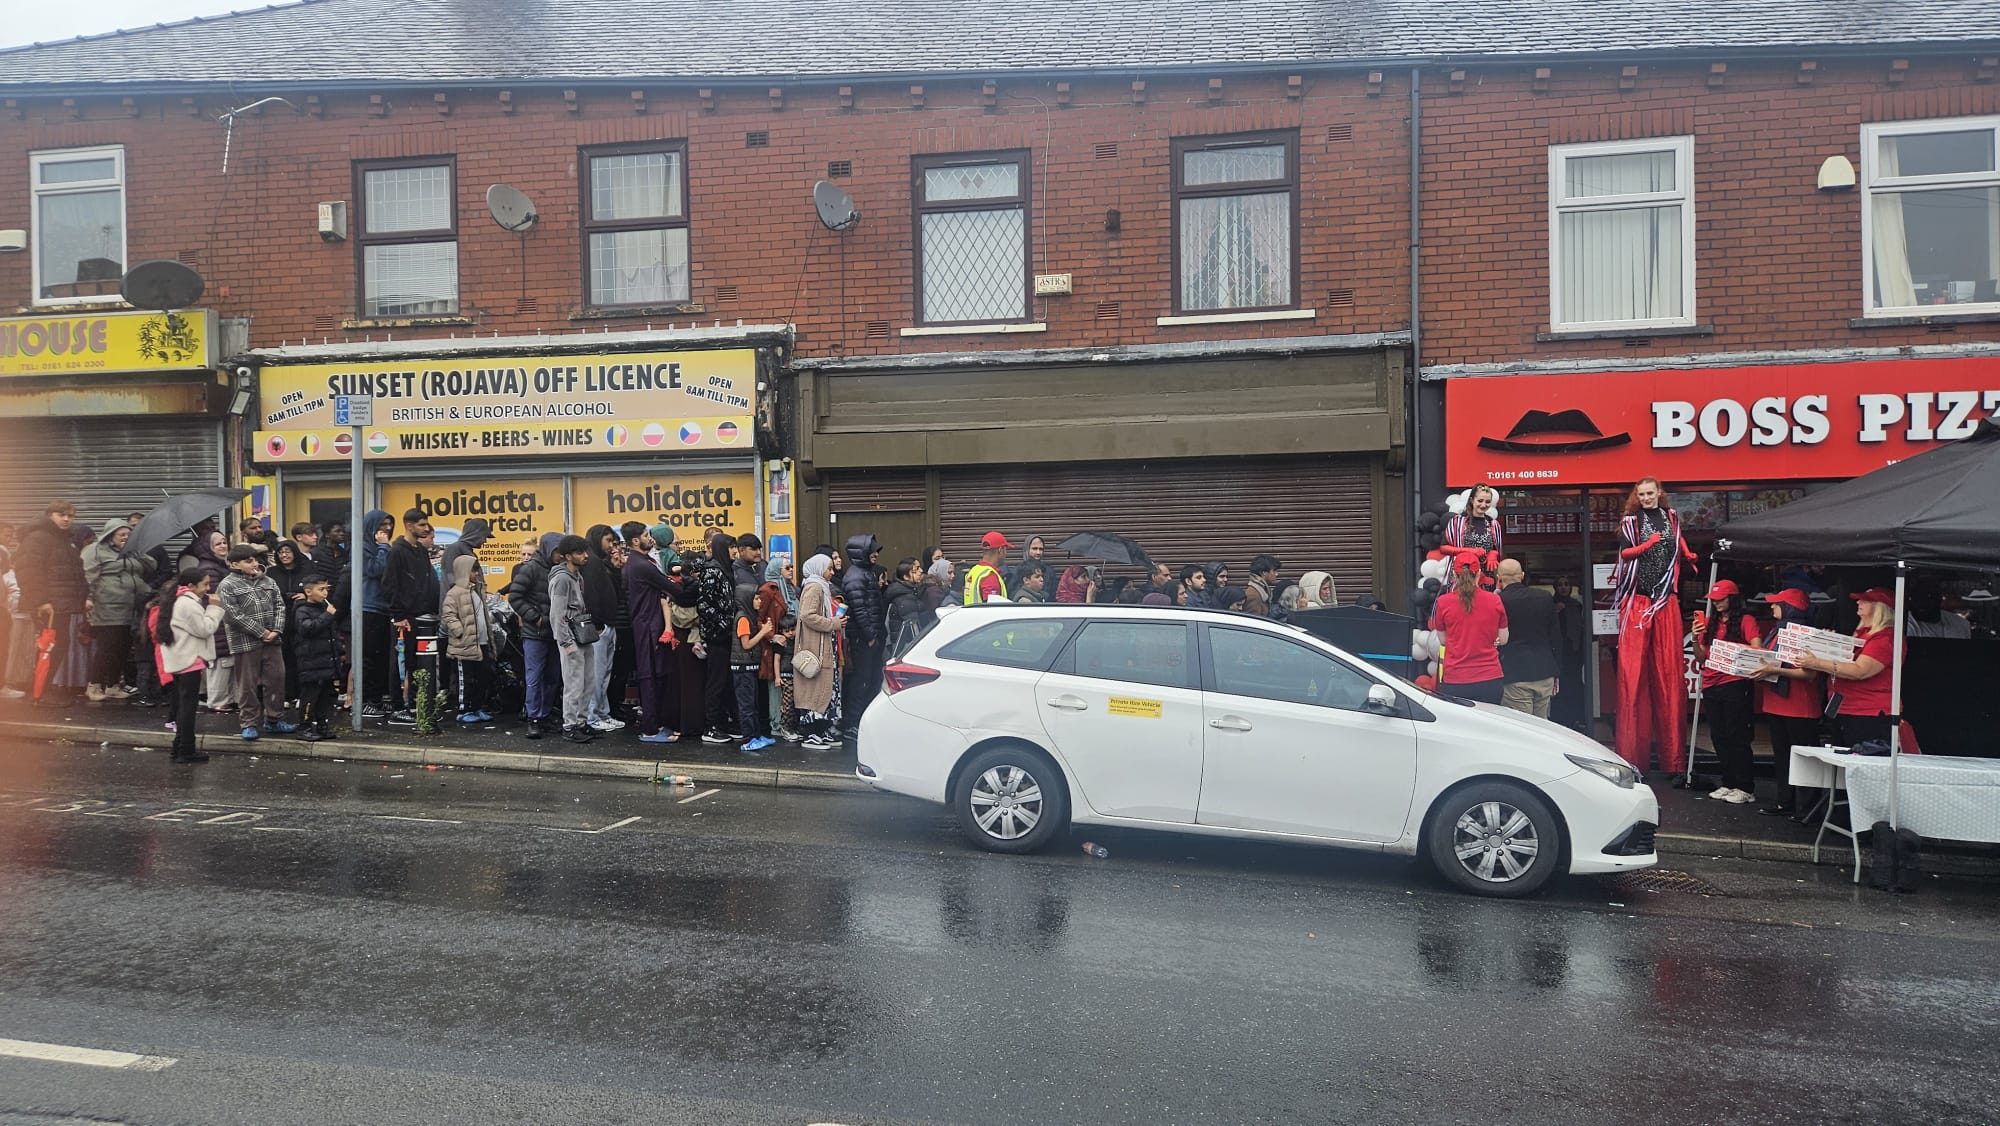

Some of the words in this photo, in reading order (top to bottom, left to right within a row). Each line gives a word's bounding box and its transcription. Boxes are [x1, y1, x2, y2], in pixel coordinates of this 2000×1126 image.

[0, 319, 107, 357] HOUSE
[328, 372, 416, 399] SUNSET
[422, 368, 527, 400] (ROJAVA)
[534, 367, 578, 393] OFF
[585, 363, 682, 391] LICENCE
[709, 376, 733, 389] OPEN
[281, 391, 303, 405] OPEN
[686, 385, 706, 398] 8AM
[707, 390, 724, 402] TILL
[727, 395, 749, 408] 11PM
[267, 411, 286, 424] 8AM
[286, 405, 303, 417] TILL
[304, 398, 325, 412] 11PM
[392, 406, 444, 420] BRITISH
[449, 406, 460, 418] &
[465, 404, 542, 418] EUROPEAN
[547, 402, 614, 417] ALCOHOL
[1651, 394, 1830, 448] BOSS
[400, 432, 469, 450] WHISKEY
[481, 430, 530, 448] BEERS
[543, 428, 593, 446] WINES
[1487, 472, 1515, 480] T:0161
[1518, 471, 1534, 479] 400
[415, 489, 544, 516] holidata.
[607, 484, 741, 514] holidata.
[658, 510, 734, 527] sorted.
[500, 541, 521, 549] easily
